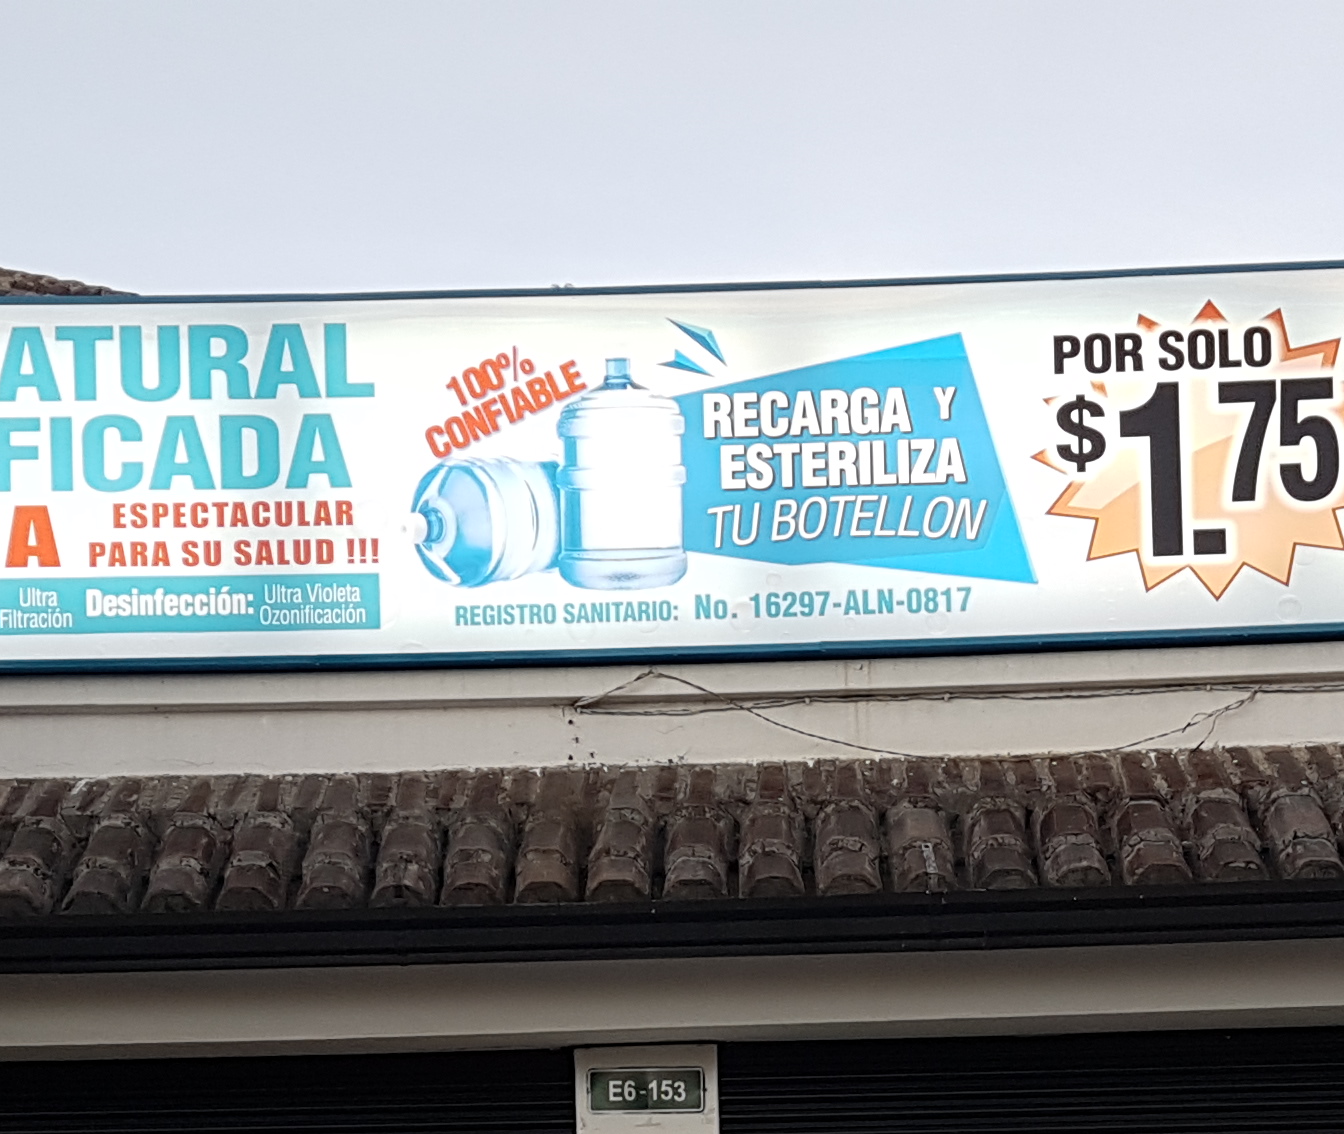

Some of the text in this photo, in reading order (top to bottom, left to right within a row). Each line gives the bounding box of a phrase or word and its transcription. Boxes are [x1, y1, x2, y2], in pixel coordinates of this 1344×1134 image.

[1053, 326, 1273, 375] POR SOLO
[446, 346, 536, 409] 100%
[425, 359, 587, 459] CONFIABLE
[702, 386, 956, 440] RECARGA Y
[719, 437, 966, 492] ESTERILIZA
[113, 500, 353, 529] ESPECTACULAR
[706, 494, 988, 549] TU BOTELLON
[89, 540, 170, 567] PARA
[183, 540, 222, 566] SU
[234, 538, 334, 565] SALUD
[18, 586, 58, 608] Ultra
[86, 582, 361, 617] Desinfección: Ultra Violeta
[260, 602, 366, 627] Ozonificación
[455, 586, 973, 627] REGISTRO SANITARIO: No. 16297-ALN-0817
[0, 606, 73, 629] Filtración
[608, 1079, 686, 1101] E6-153
